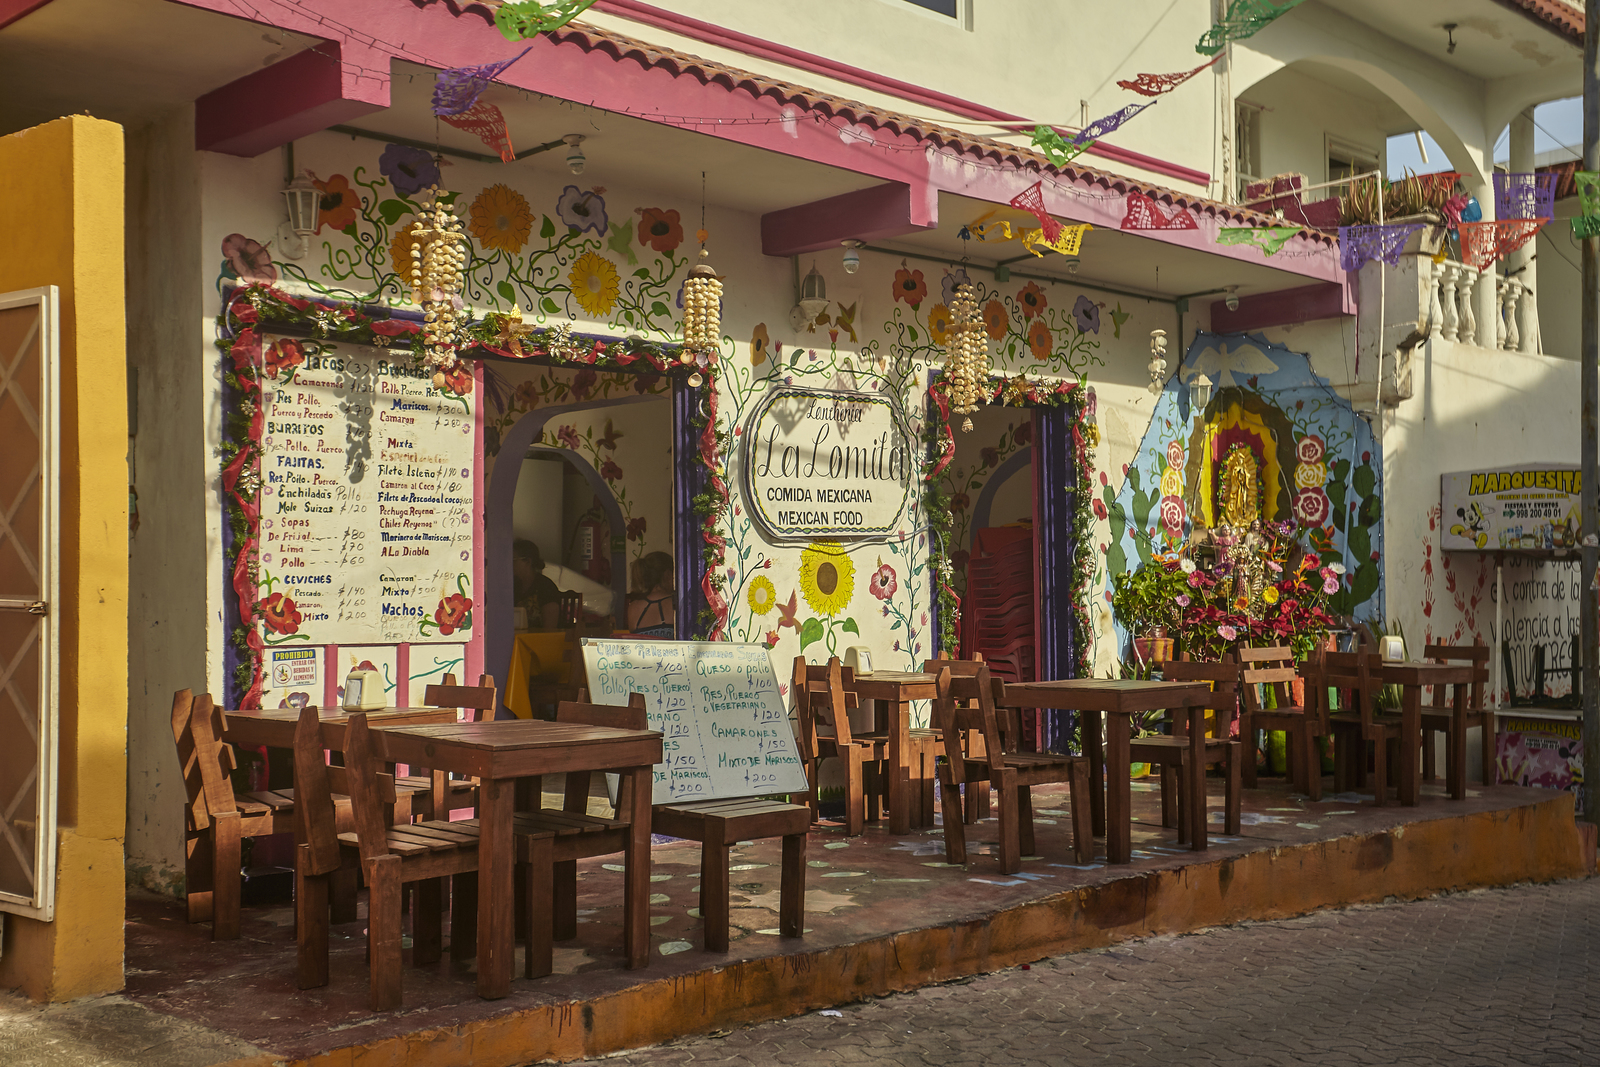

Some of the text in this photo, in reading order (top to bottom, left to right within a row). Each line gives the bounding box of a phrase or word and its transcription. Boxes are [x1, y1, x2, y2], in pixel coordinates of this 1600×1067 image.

[302, 351, 344, 371] Tacos
[381, 381, 399, 394] Pollo
[276, 389, 292, 403] Res
[267, 422, 325, 435] BURRITOS
[757, 423, 906, 481] La Lomita
[377, 464, 403, 477] Filete
[377, 492, 399, 502] Filete
[766, 488, 872, 503] COMIDA MEXICANA
[276, 501, 367, 515] Mole Suizas $120
[379, 505, 408, 518] Pechuga
[1516, 508, 1528, 518] 998
[1530, 508, 1542, 518] 200
[1543, 508, 1552, 518] 49
[1553, 508, 1561, 517] 01
[281, 517, 310, 529] Sopas
[380, 518, 401, 528] Chiles
[778, 511, 863, 525] MEXICAN FOOD
[267, 532, 279, 542] De
[342, 526, 365, 541] $80
[279, 540, 364, 554] Lima $70
[402, 546, 430, 557] Diabla
[281, 553, 365, 568] Pollo $60
[284, 575, 332, 584] CEVICHES
[1513, 571, 1549, 603] contra
[1551, 570, 1565, 602] de
[1571, 571, 1581, 602] la
[381, 586, 409, 597] Mixto
[382, 603, 424, 616] Nachos
[302, 612, 329, 622] Mixto
[1553, 615, 1564, 639] a
[275, 651, 313, 660] PROHIBIDO
[597, 657, 682, 674] QUESO $100
[696, 660, 731, 678] QUESO
[748, 674, 772, 690] $100
[726, 683, 760, 700] PUERCO
[657, 692, 686, 710] $120
[710, 701, 767, 712] VEGETARIANO
[753, 708, 781, 721] $120
[660, 721, 689, 734] $120
[711, 722, 778, 738] CAMARONES
[1507, 720, 1581, 741] MARQUESITAS
[758, 737, 786, 753] $150
[666, 752, 695, 769] $150
[718, 752, 747, 768] MIXTO
[765, 754, 799, 766] MARISCOS
[744, 769, 776, 787] $200
[669, 780, 702, 796] $200
